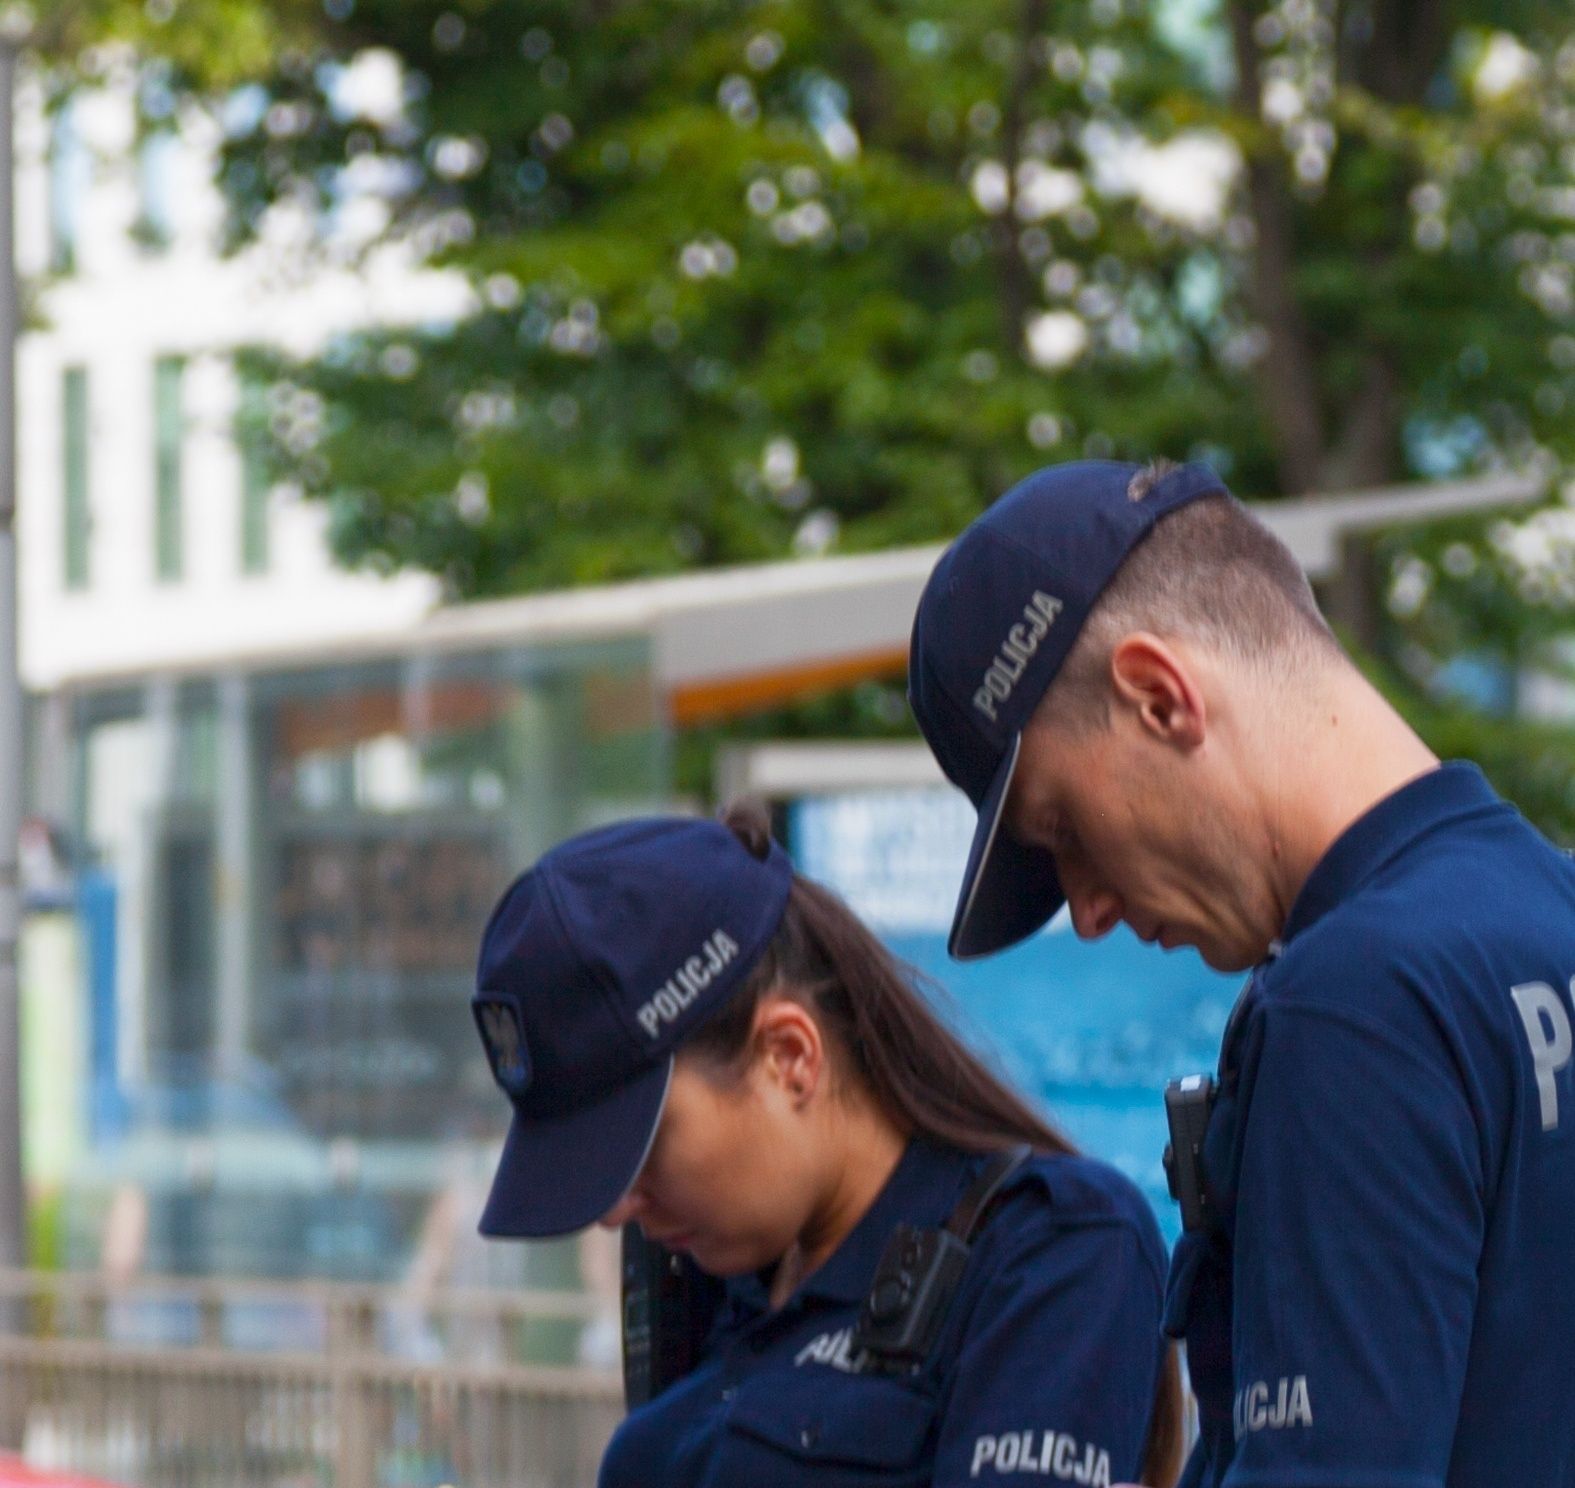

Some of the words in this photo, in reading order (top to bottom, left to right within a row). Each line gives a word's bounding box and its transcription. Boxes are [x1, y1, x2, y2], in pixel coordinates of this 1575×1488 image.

[973, 589, 1063, 721] POLICJA
[637, 928, 739, 1039] POLICJA
[1510, 974, 1575, 1132] P
